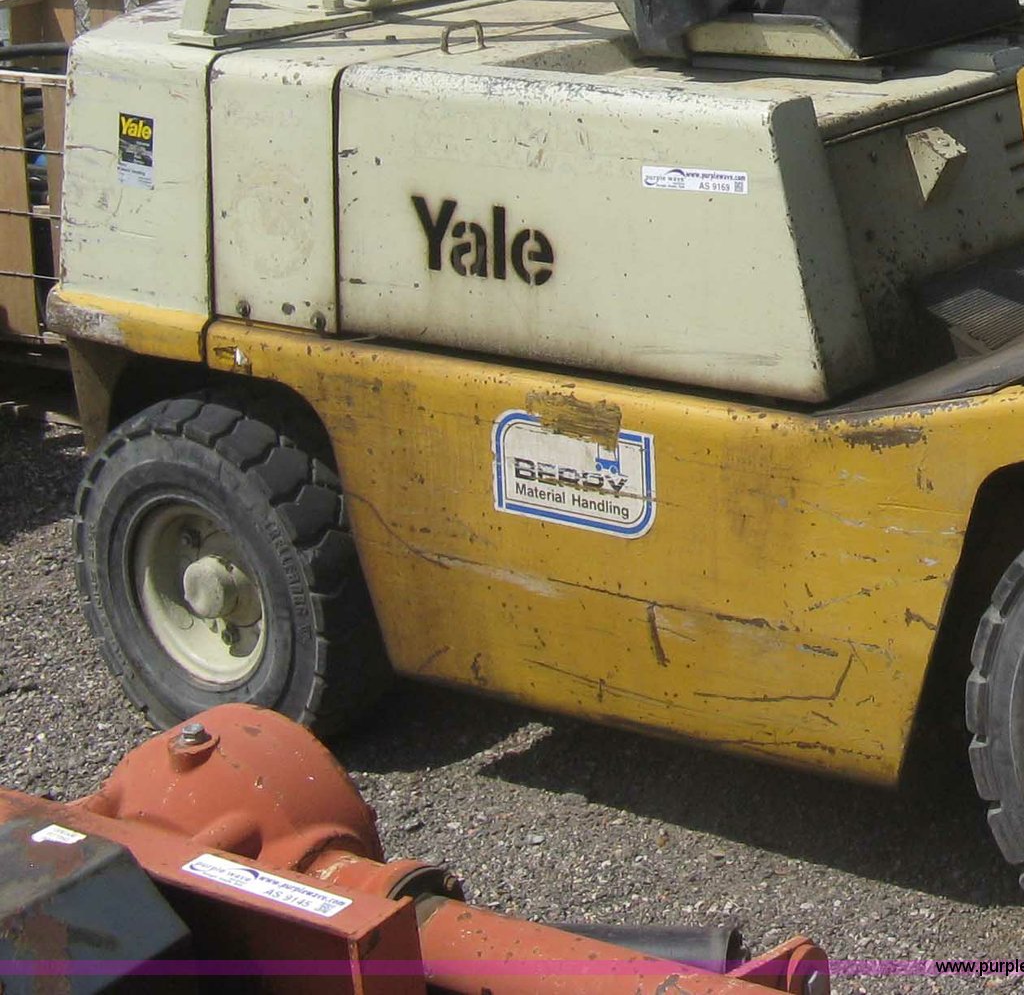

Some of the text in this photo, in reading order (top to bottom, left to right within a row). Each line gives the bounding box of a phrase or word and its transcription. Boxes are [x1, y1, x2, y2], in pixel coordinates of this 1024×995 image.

[121, 116, 152, 140] Yale
[699, 181, 710, 190] AS
[411, 195, 554, 286] Yale
[515, 482, 629, 520] Material Handling
[263, 888, 282, 898] AS
